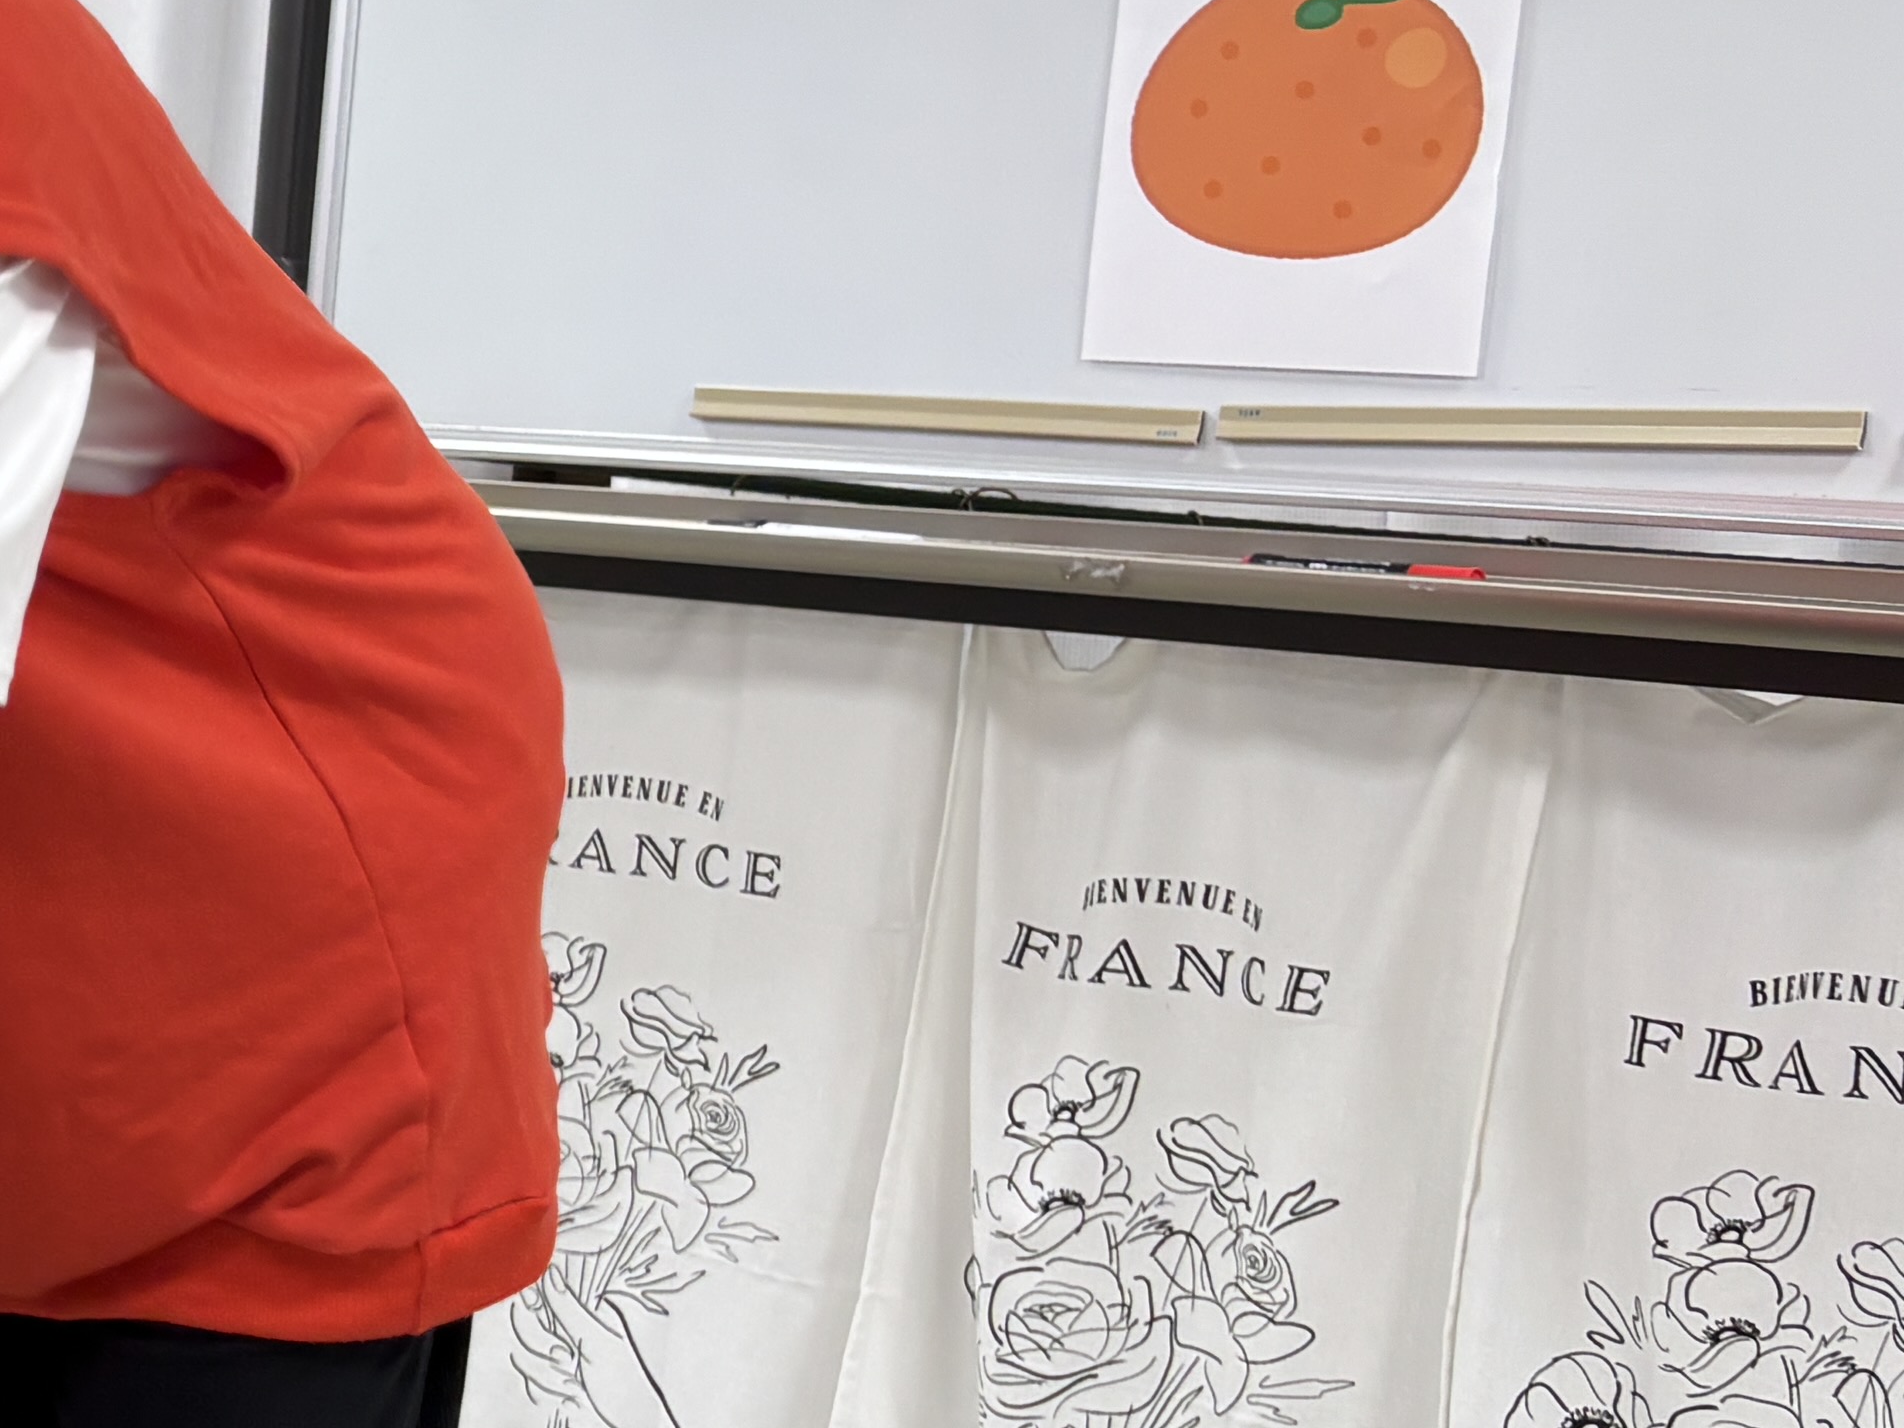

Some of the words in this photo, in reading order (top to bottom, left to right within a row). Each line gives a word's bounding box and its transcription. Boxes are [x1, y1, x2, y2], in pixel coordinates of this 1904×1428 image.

[698, 790, 725, 822] EN
[548, 827, 781, 898] ANCE
[1002, 921, 1331, 1016] FRANCE
[1749, 971, 1904, 1009] BIENVENU
